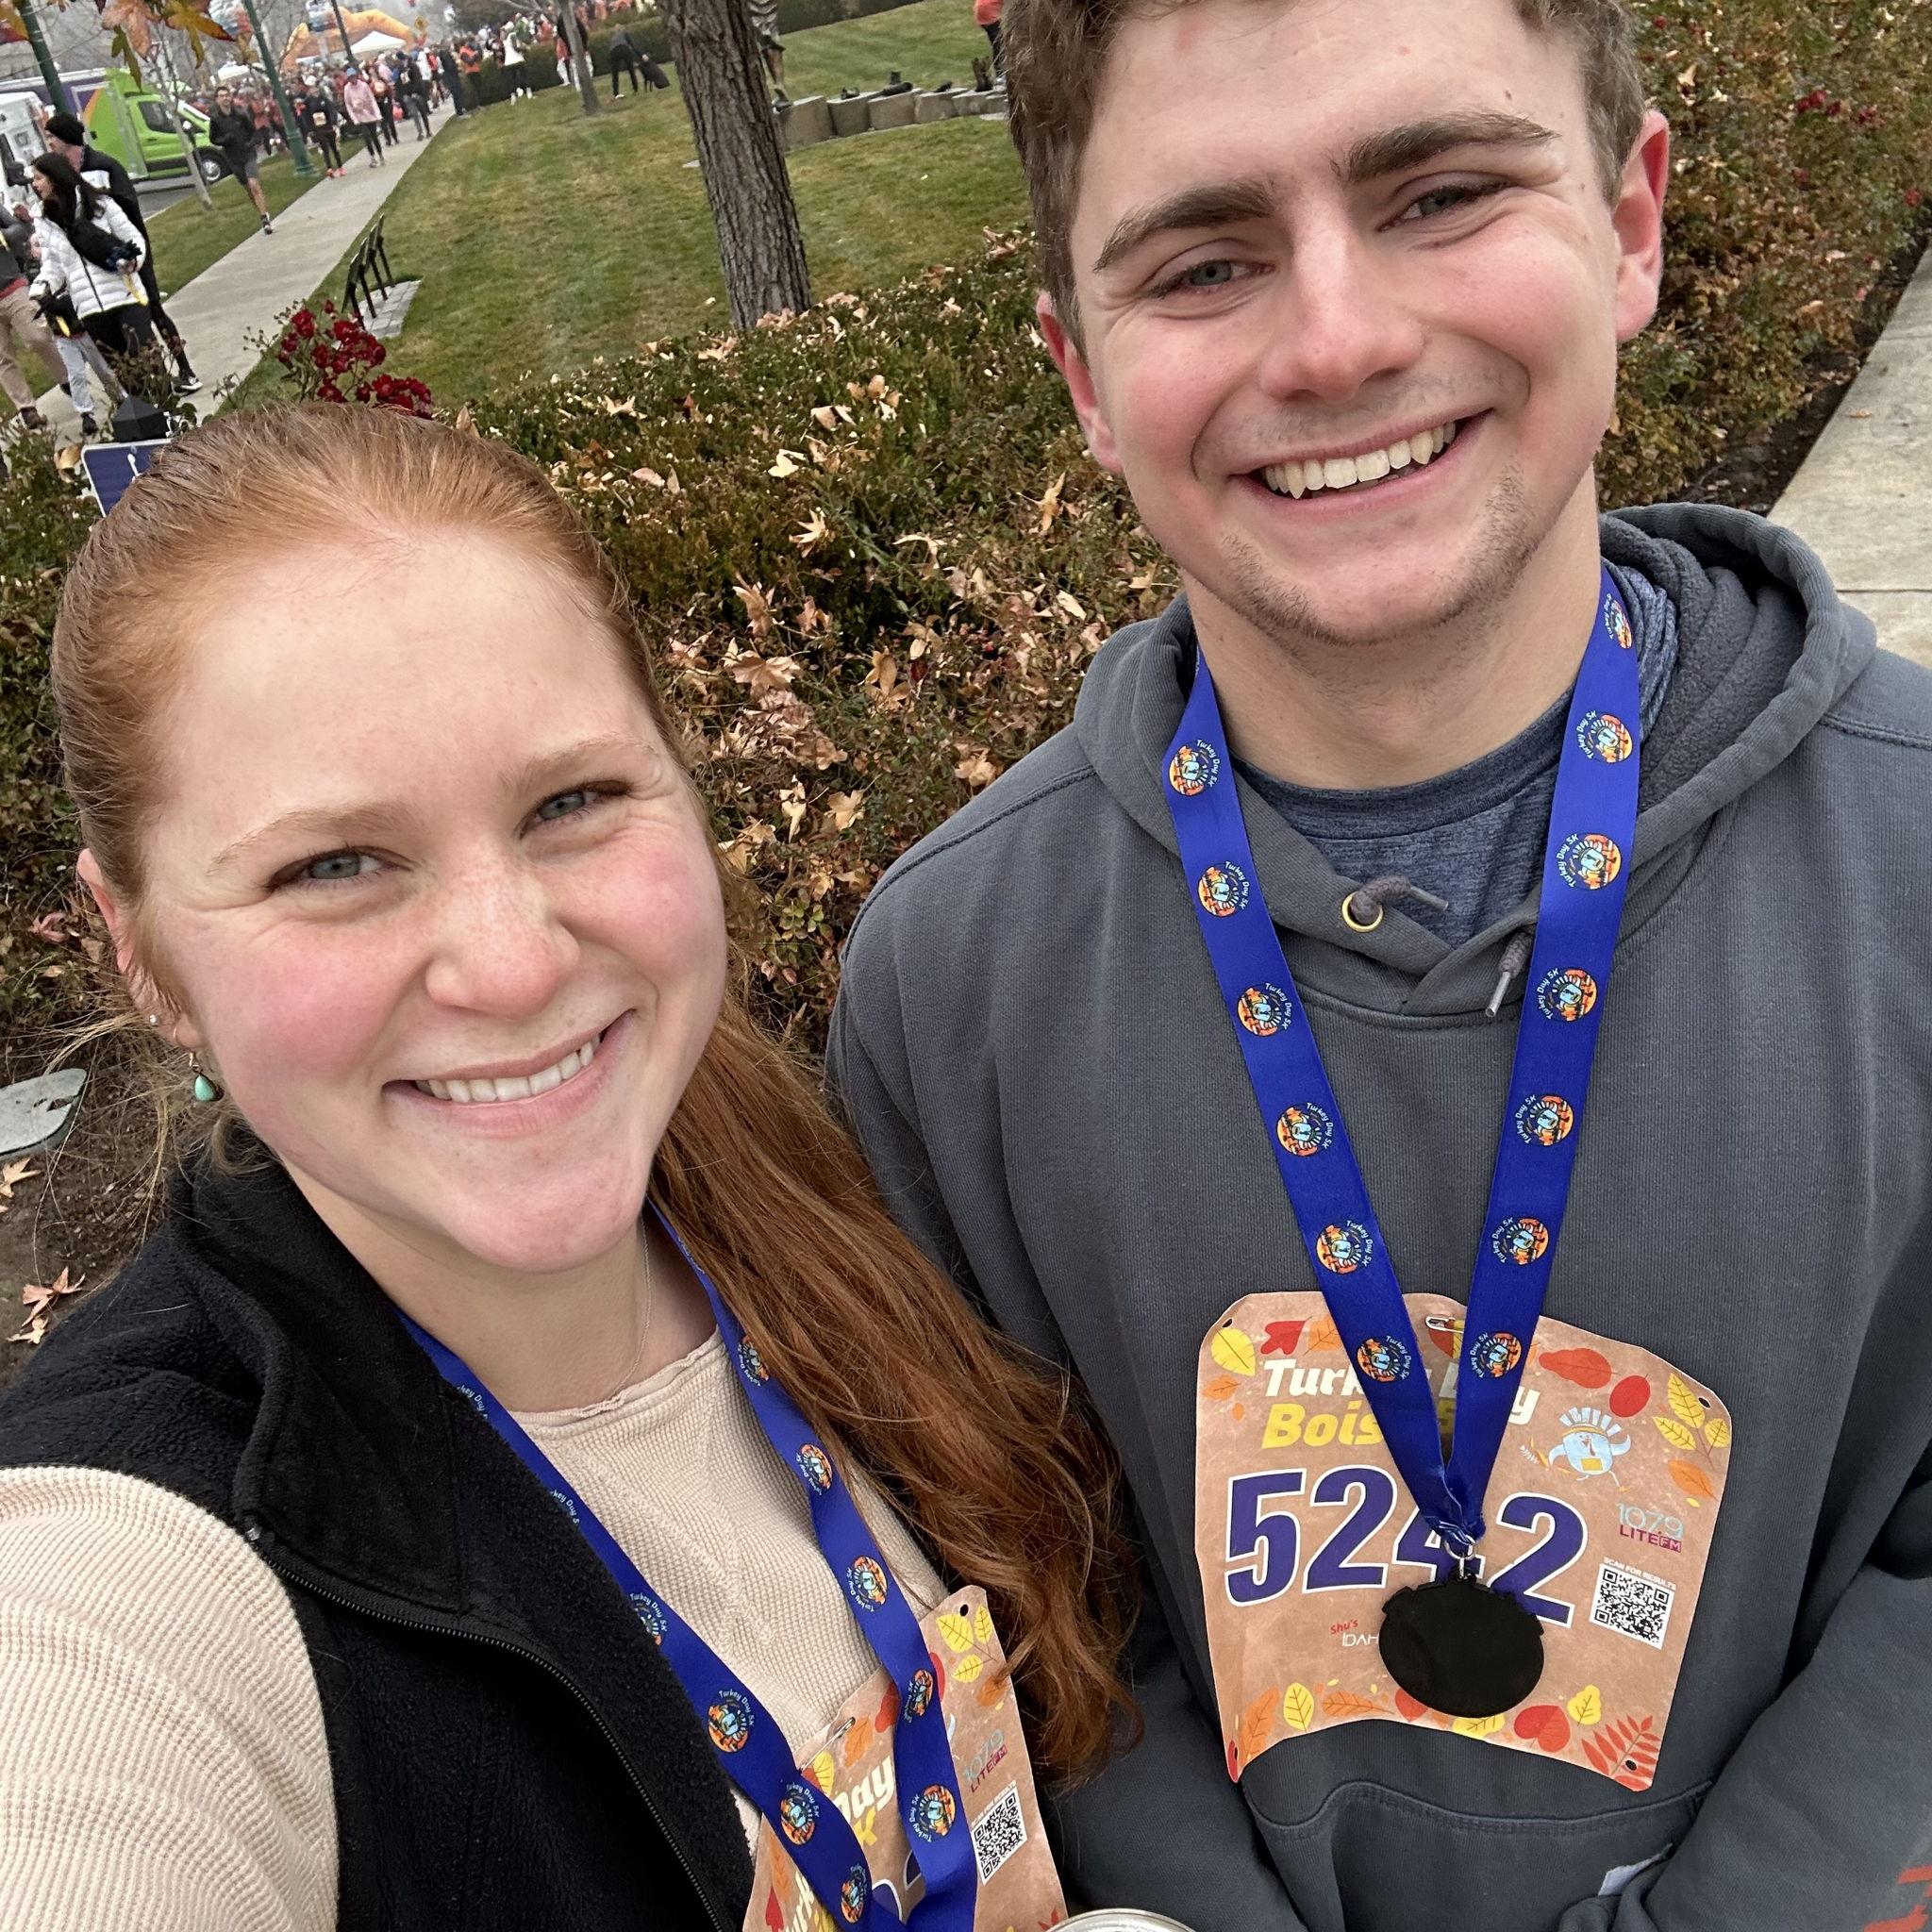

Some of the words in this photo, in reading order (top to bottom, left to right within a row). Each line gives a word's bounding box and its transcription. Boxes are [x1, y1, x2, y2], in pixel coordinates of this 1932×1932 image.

[1576, 718, 1589, 732] Day
[1578, 734, 1593, 758] Turkey
[1197, 740, 1216, 758] Turkey
[1211, 758, 1220, 774] Day
[1557, 845, 1570, 858] Day
[1226, 861, 1245, 880] Turkey
[1558, 861, 1576, 887] Turkey
[1265, 983, 1287, 1001] Turkey
[1537, 978, 1550, 992] Day
[1539, 995, 1553, 1019] Turkey
[1307, 1103, 1328, 1122] Turkey
[1515, 1105, 1527, 1118] Day
[1517, 1120, 1531, 1144] Turkey
[1347, 1221, 1369, 1239] Turkey
[1492, 1225, 1504, 1239] Day
[1492, 1241, 1507, 1263] Turkey
[1262, 1400, 1384, 1449] Bois
[1341, 1632, 1379, 1647] IDAH
[913, 1823, 932, 1842] Turkey
